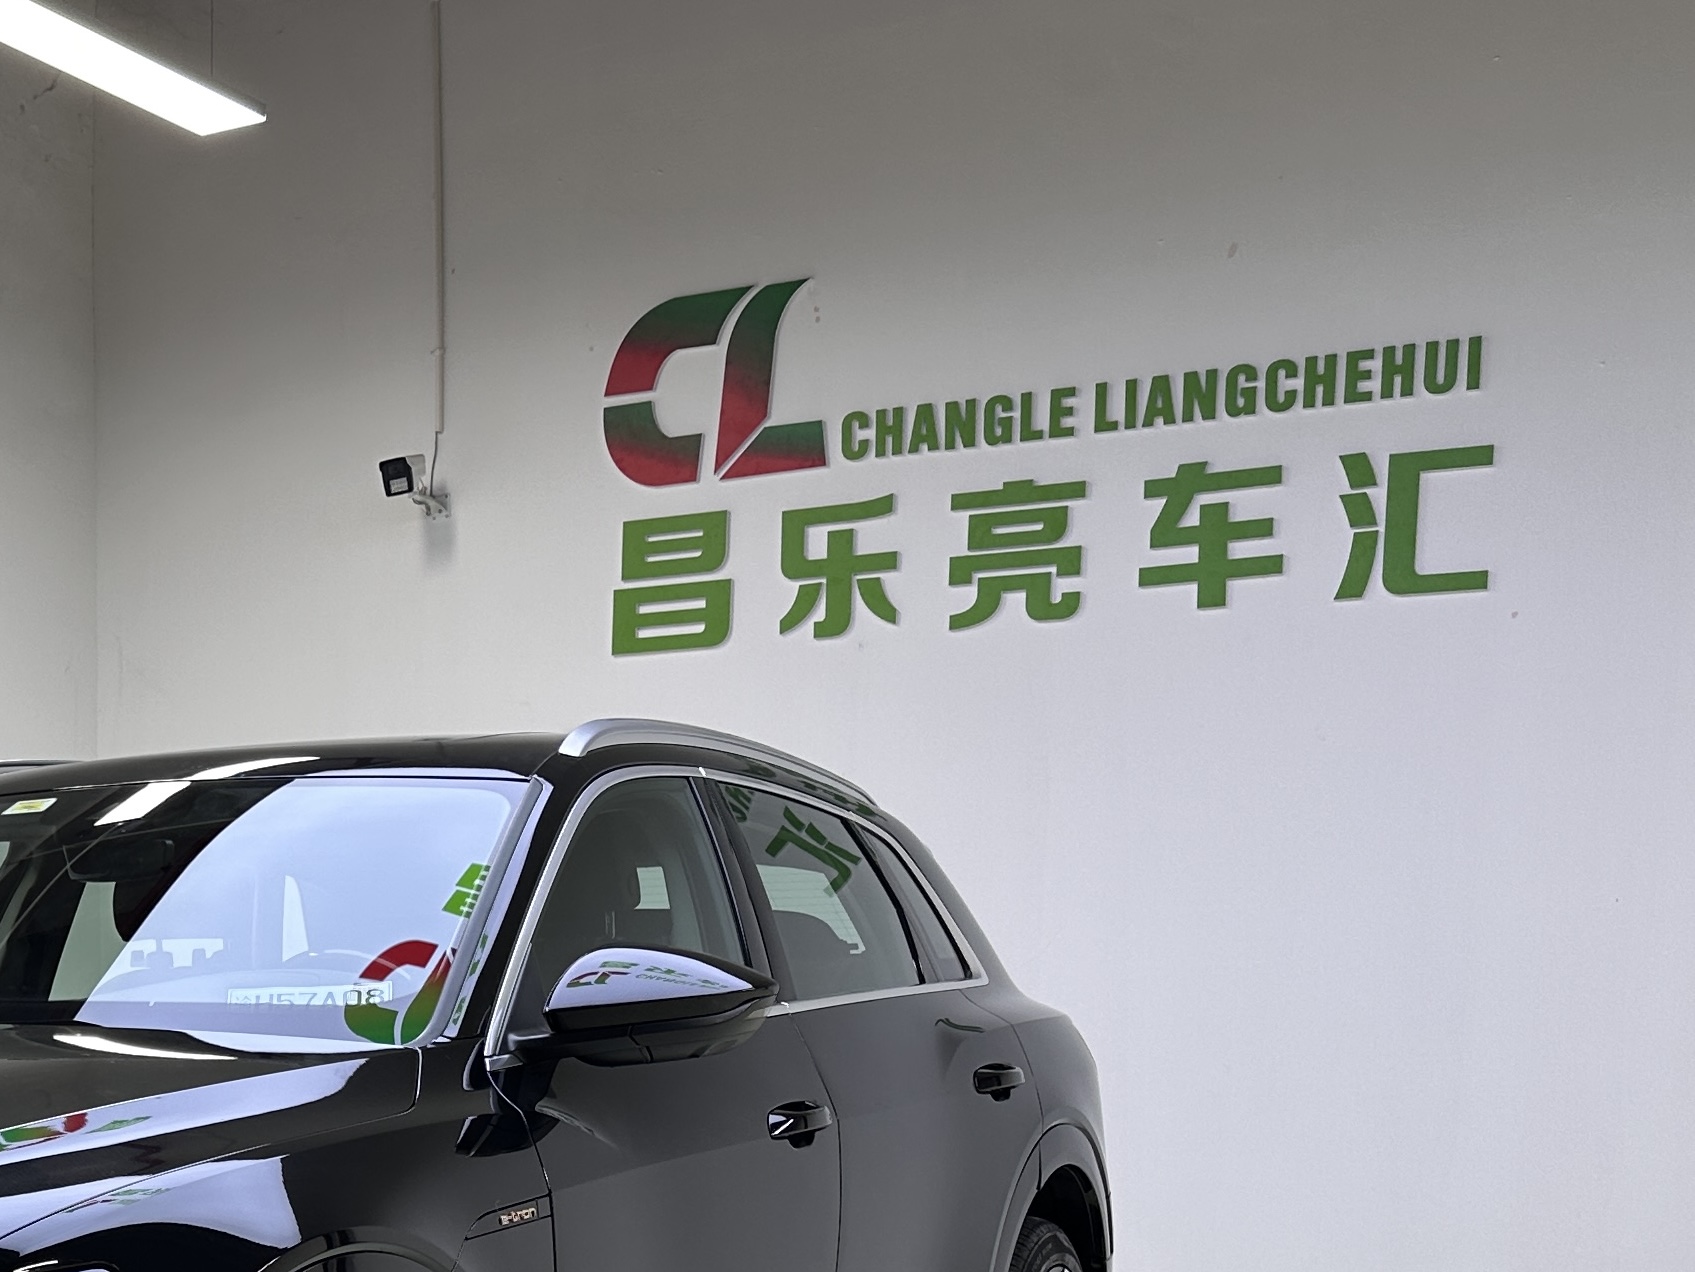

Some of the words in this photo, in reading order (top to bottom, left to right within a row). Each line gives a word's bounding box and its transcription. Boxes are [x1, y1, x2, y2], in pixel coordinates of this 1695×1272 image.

[840, 387, 1077, 462] CHANGLE
[1092, 335, 1484, 434] LIANGCHEHUI
[610, 443, 1495, 656] 昌乐亮车汇
[498, 1207, 537, 1227] e-tron
